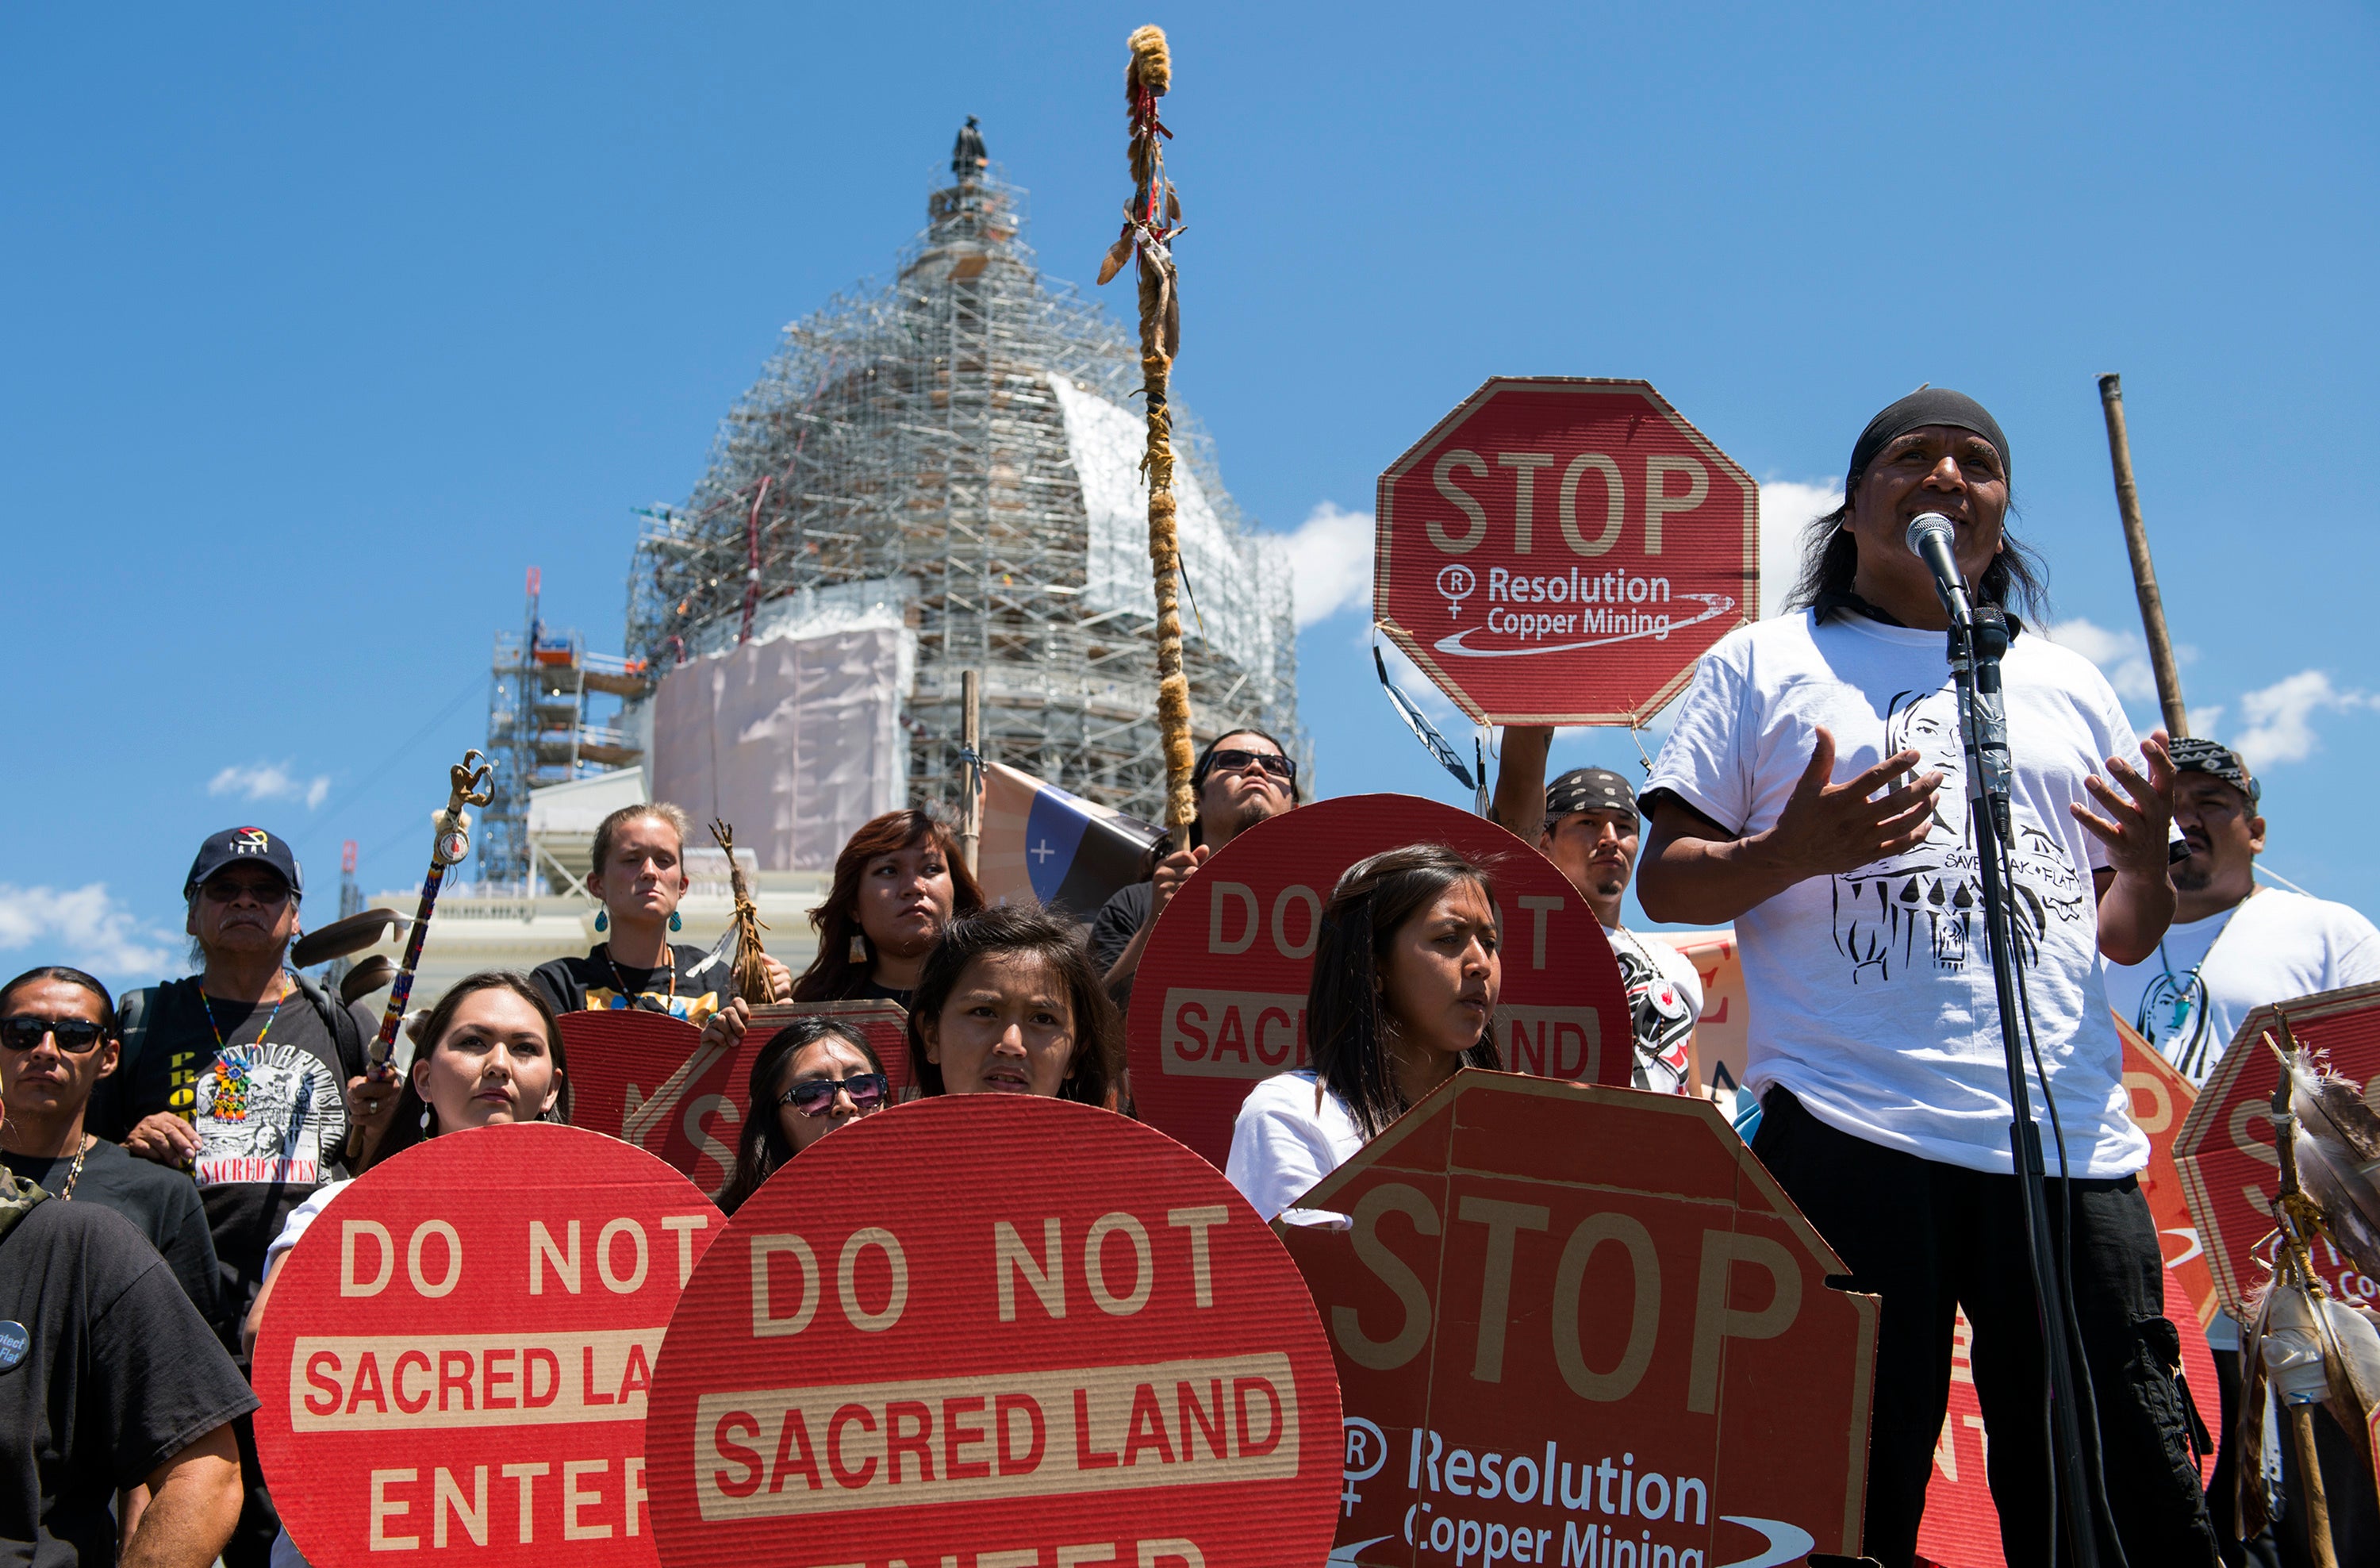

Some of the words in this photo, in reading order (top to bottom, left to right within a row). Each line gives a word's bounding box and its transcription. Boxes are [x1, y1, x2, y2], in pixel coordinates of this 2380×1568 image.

[1425, 449, 1710, 556] STOP
[1488, 567, 1670, 603] Resolution
[1488, 607, 1577, 640] Copper
[1583, 608, 1670, 641] Mining
[1945, 853, 1981, 871] SAVE
[2042, 867, 2075, 891] FLAT
[1208, 881, 1323, 959] DO
[1174, 1001, 1307, 1066] SAC
[1511, 1020, 1588, 1080] ND
[201, 1158, 266, 1185] SACRED
[271, 1159, 317, 1182] SITES
[340, 1219, 463, 1298] DO
[529, 1215, 708, 1295] NOT
[751, 1227, 908, 1338] DO
[994, 1204, 1229, 1323] NOT
[1331, 1183, 1803, 1415] STOP
[0, 1334, 25, 1350] otect
[304, 1347, 560, 1416] SACRED
[583, 1343, 653, 1406] LA
[714, 1393, 1046, 1498] SACRED
[1074, 1376, 1284, 1470] LAND
[1408, 1428, 1708, 1525] Resolution
[1403, 1502, 1553, 1568] Copper
